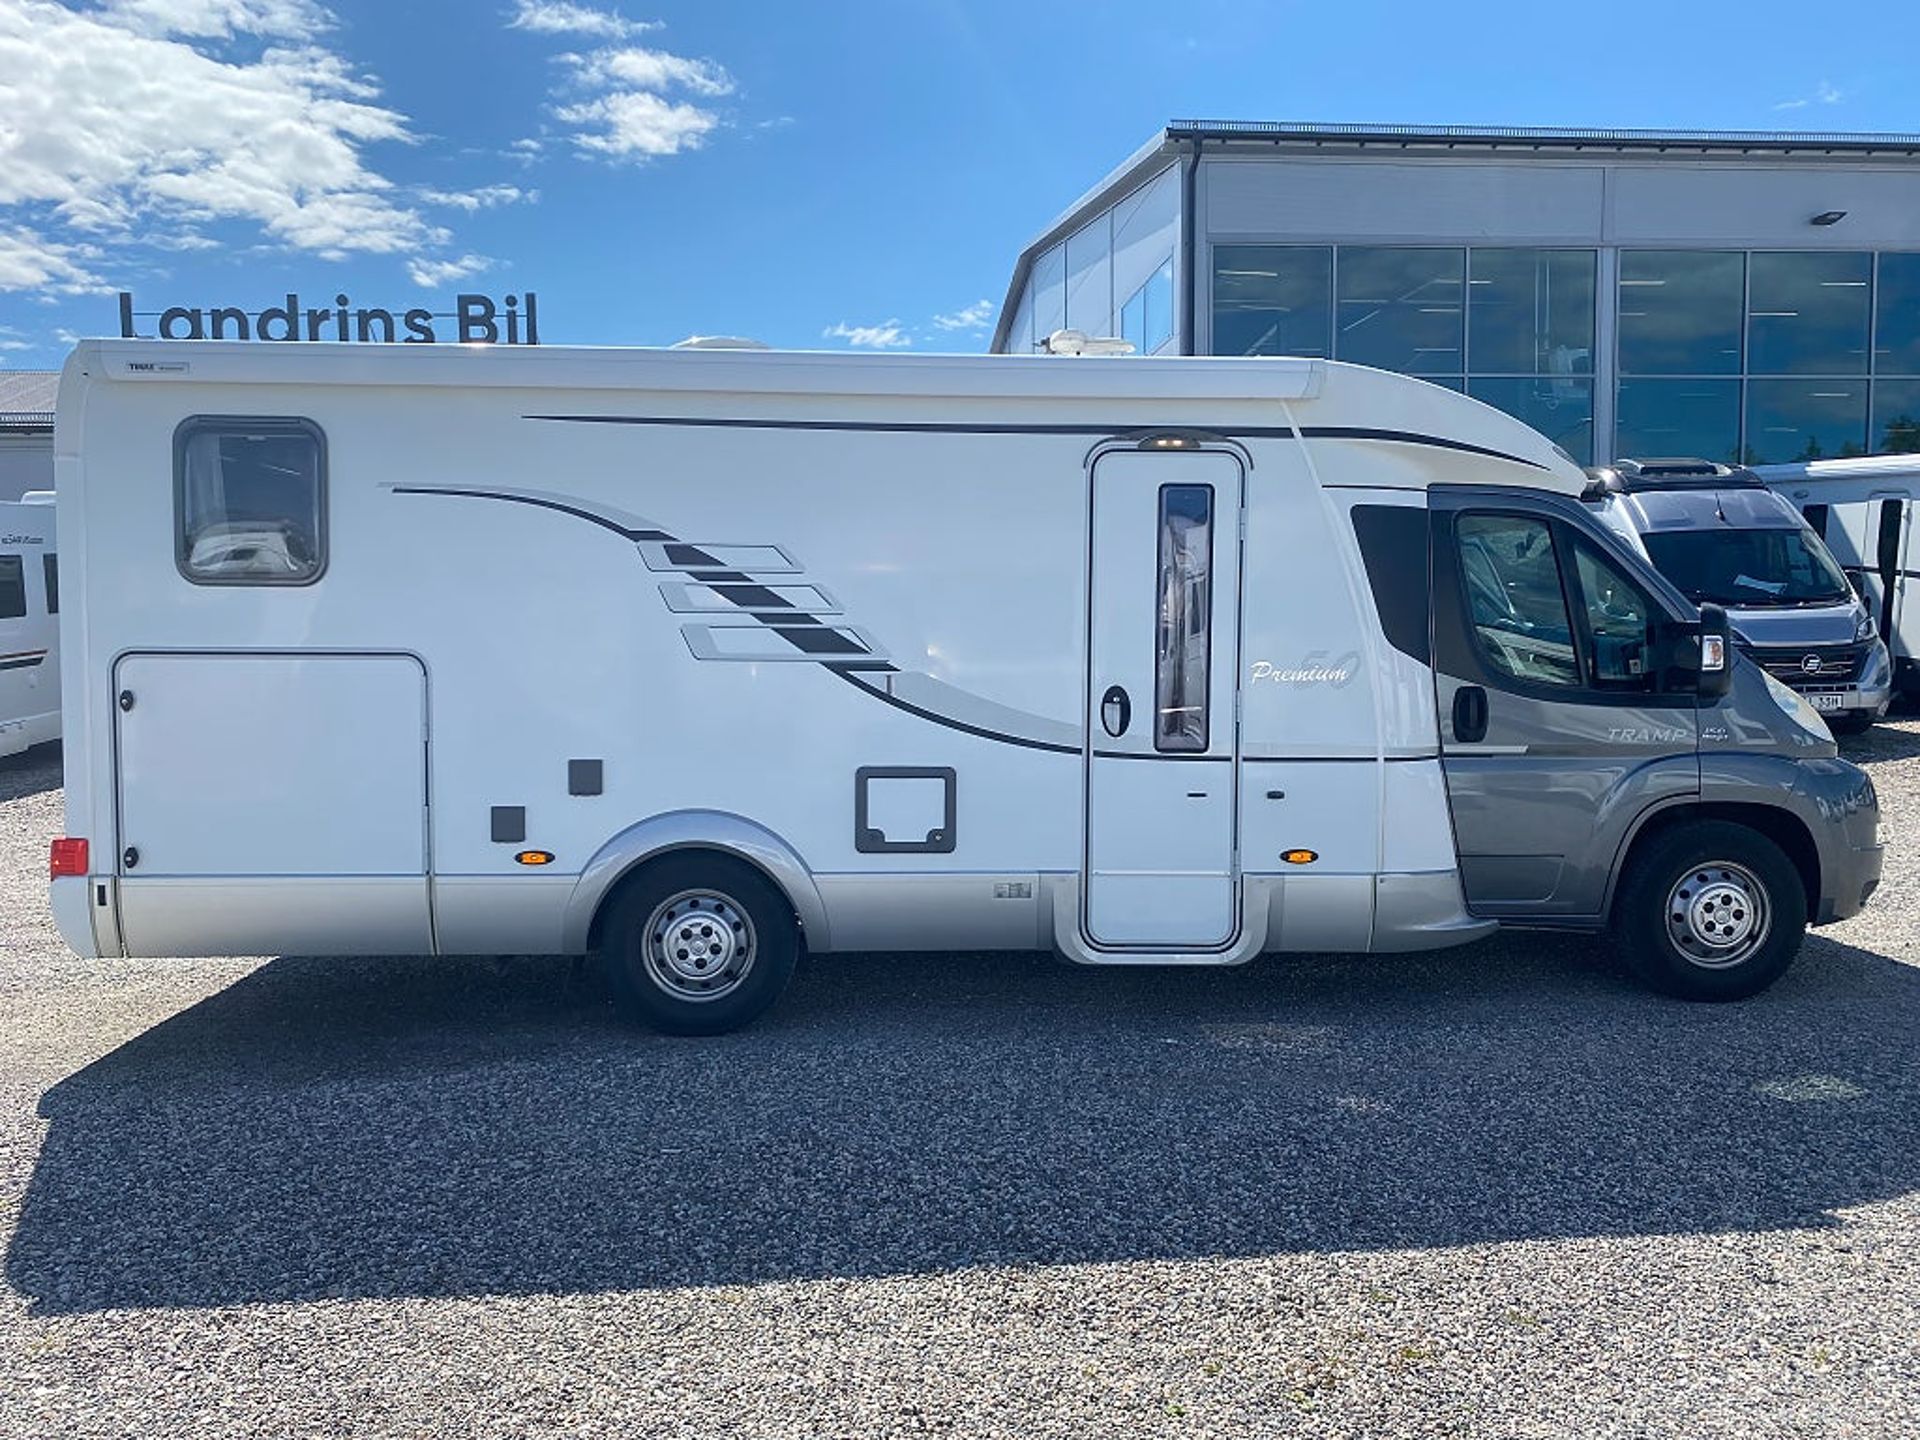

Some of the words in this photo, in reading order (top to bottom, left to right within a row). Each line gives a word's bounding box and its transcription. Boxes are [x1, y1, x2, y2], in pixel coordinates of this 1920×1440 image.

[119, 292, 436, 343] Landrins
[457, 292, 538, 345] Bil
[1250, 660, 1350, 685] Premium
[1608, 728, 1688, 742] TRAMP
